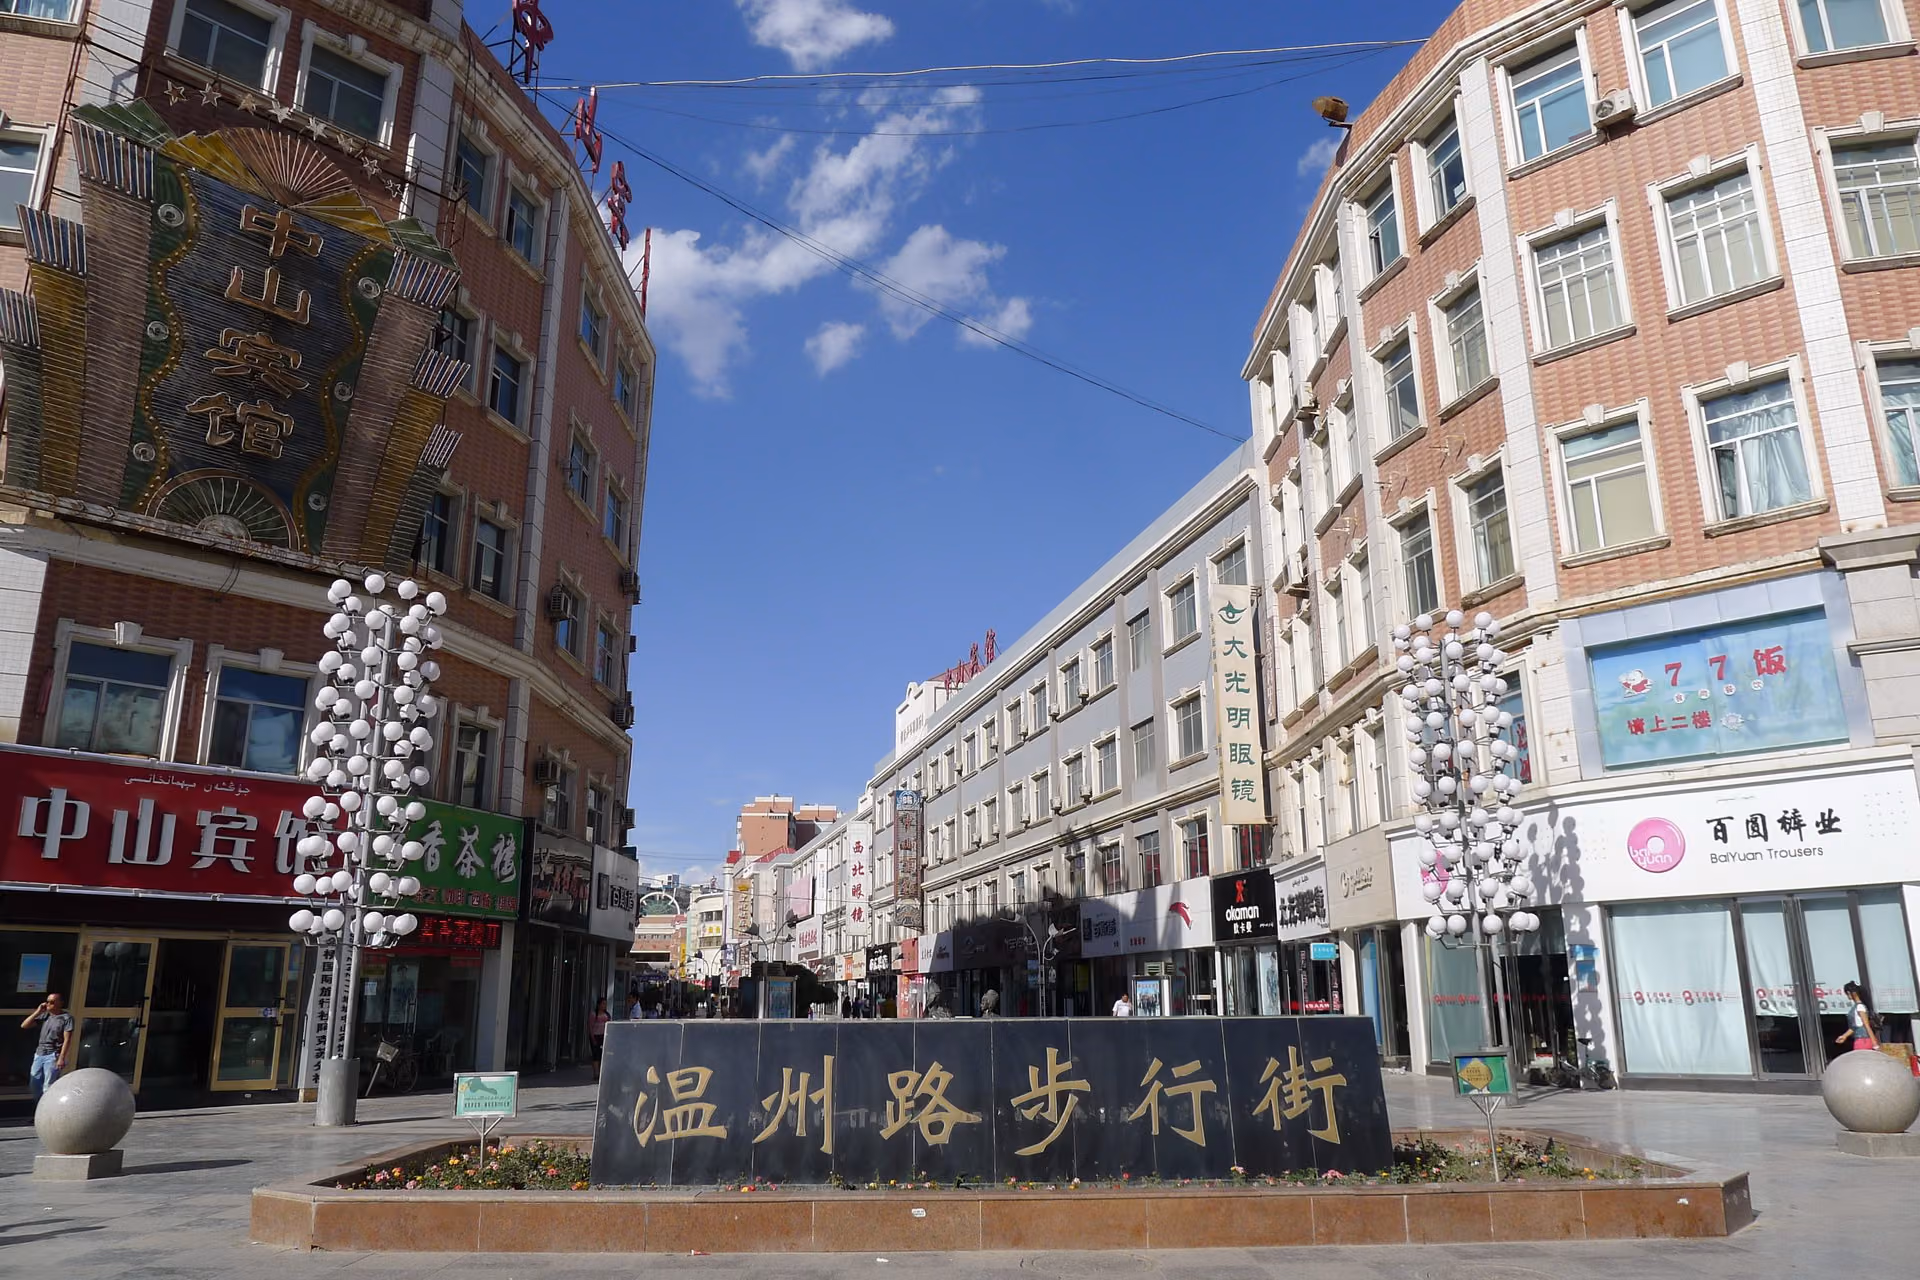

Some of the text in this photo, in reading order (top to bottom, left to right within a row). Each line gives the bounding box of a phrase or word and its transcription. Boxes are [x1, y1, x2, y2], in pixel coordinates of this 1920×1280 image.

[186, 203, 323, 458] 中山宾馆
[1223, 635, 1257, 803] 大光明眼镜
[1627, 710, 1712, 736] 请上二楼
[17, 786, 332, 878] 中山宾馆
[388, 820, 517, 884] 香茶楼
[1767, 846, 1824, 860] Trousers
[851, 841, 868, 924] 西北眼镜
[1225, 905, 1260, 922] okaman
[1233, 922, 1253, 935] 欧卡曼
[633, 1045, 1348, 1157] 温州路步行街
